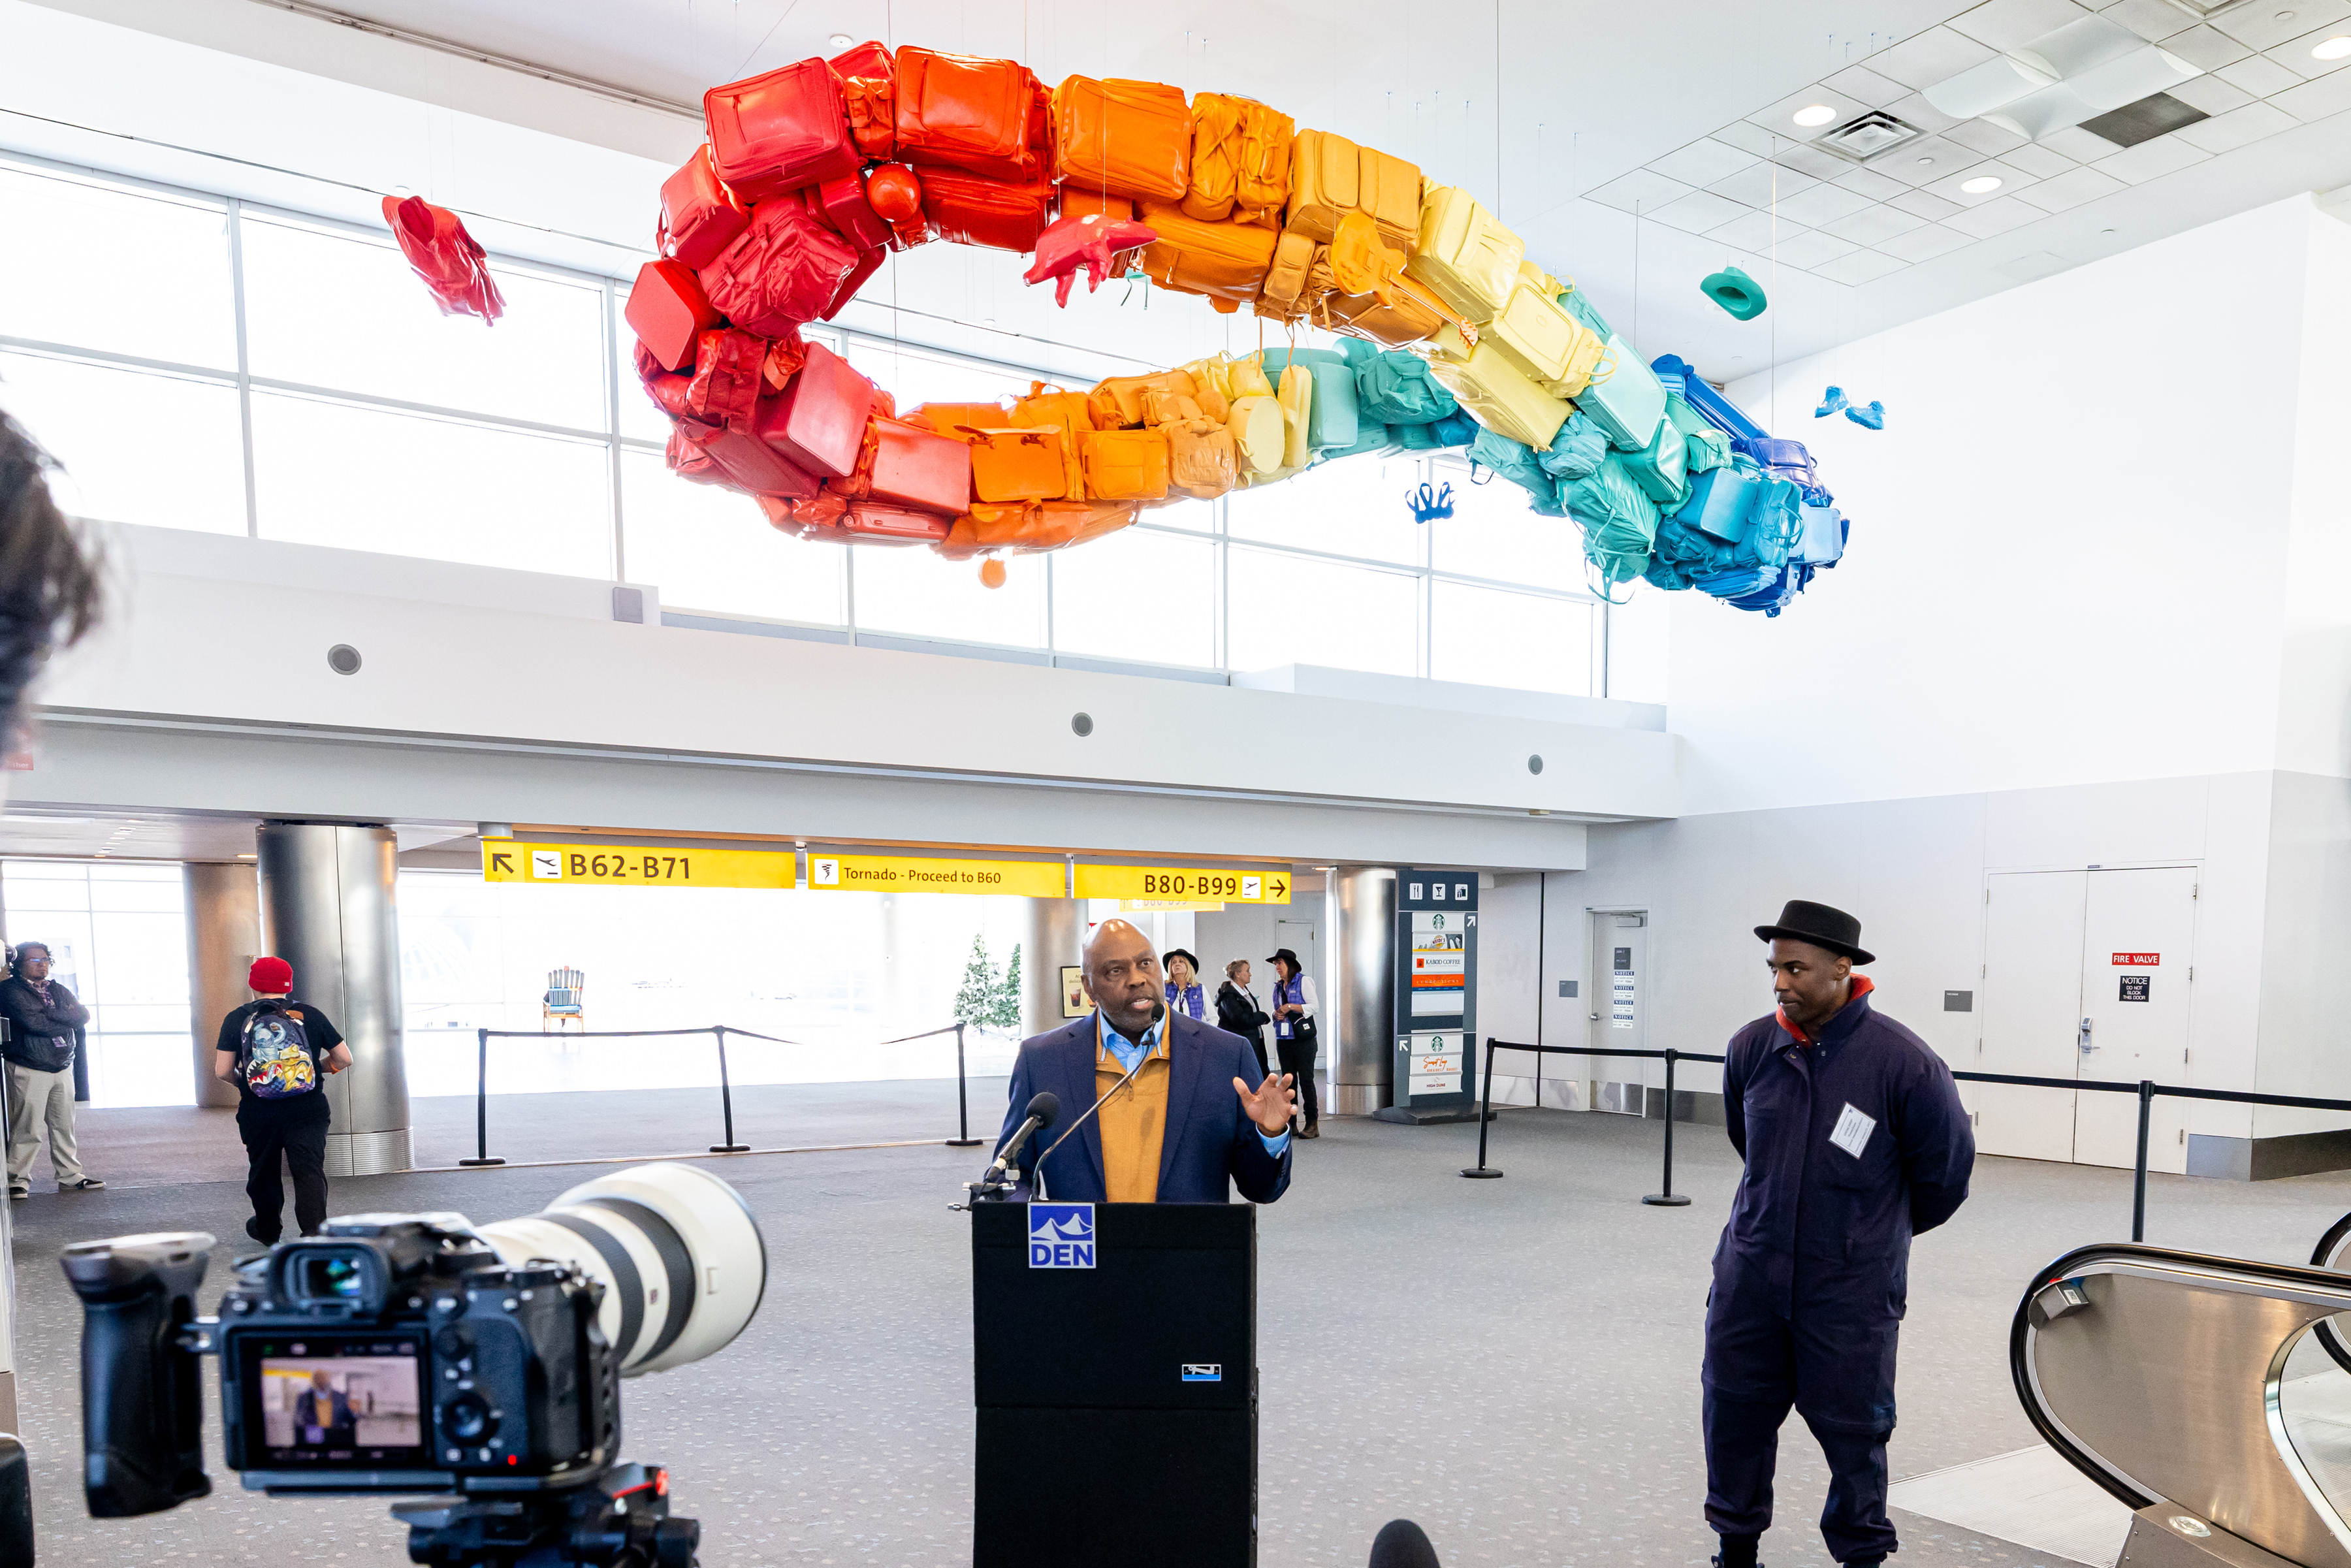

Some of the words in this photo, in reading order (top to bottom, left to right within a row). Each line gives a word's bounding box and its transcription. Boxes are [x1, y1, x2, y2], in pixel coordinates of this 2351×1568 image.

[570, 854, 690, 880] B62-B71
[844, 867, 897, 881] Tornado
[908, 869, 957, 883] Proceed
[961, 872, 974, 883] to
[978, 871, 1001, 884] B60
[1144, 874, 1236, 896] B80-B99
[1031, 1244, 1093, 1266] DEN
